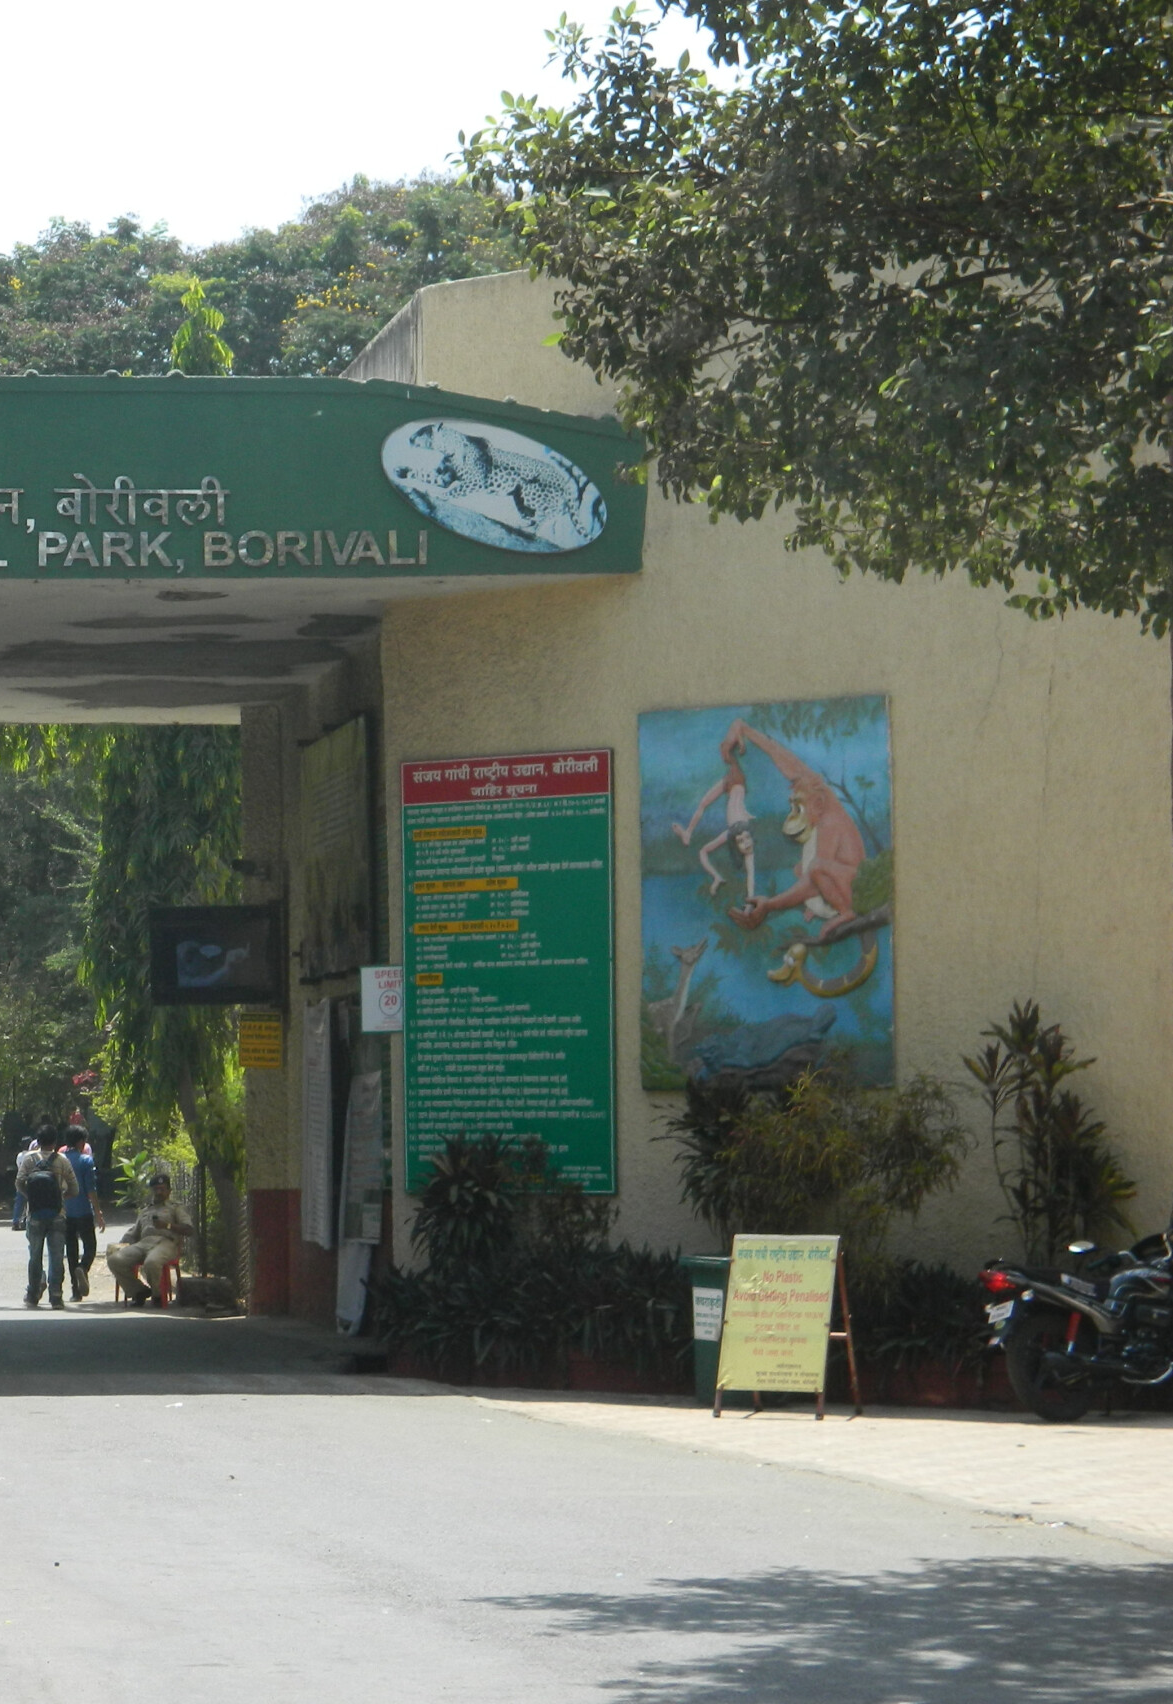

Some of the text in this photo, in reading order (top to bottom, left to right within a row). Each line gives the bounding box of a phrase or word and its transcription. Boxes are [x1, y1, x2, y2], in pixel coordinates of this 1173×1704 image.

[53, 472, 231, 526] बोरीवली
[38, 531, 185, 573] PARK,
[204, 530, 428, 568] BORIVALI
[412, 767, 441, 784] संजय
[444, 764, 470, 782] गांधी
[552, 755, 598, 774] बोरीवली
[384, 995, 398, 1007] 20
[762, 1269, 804, 1284] No Plastic
